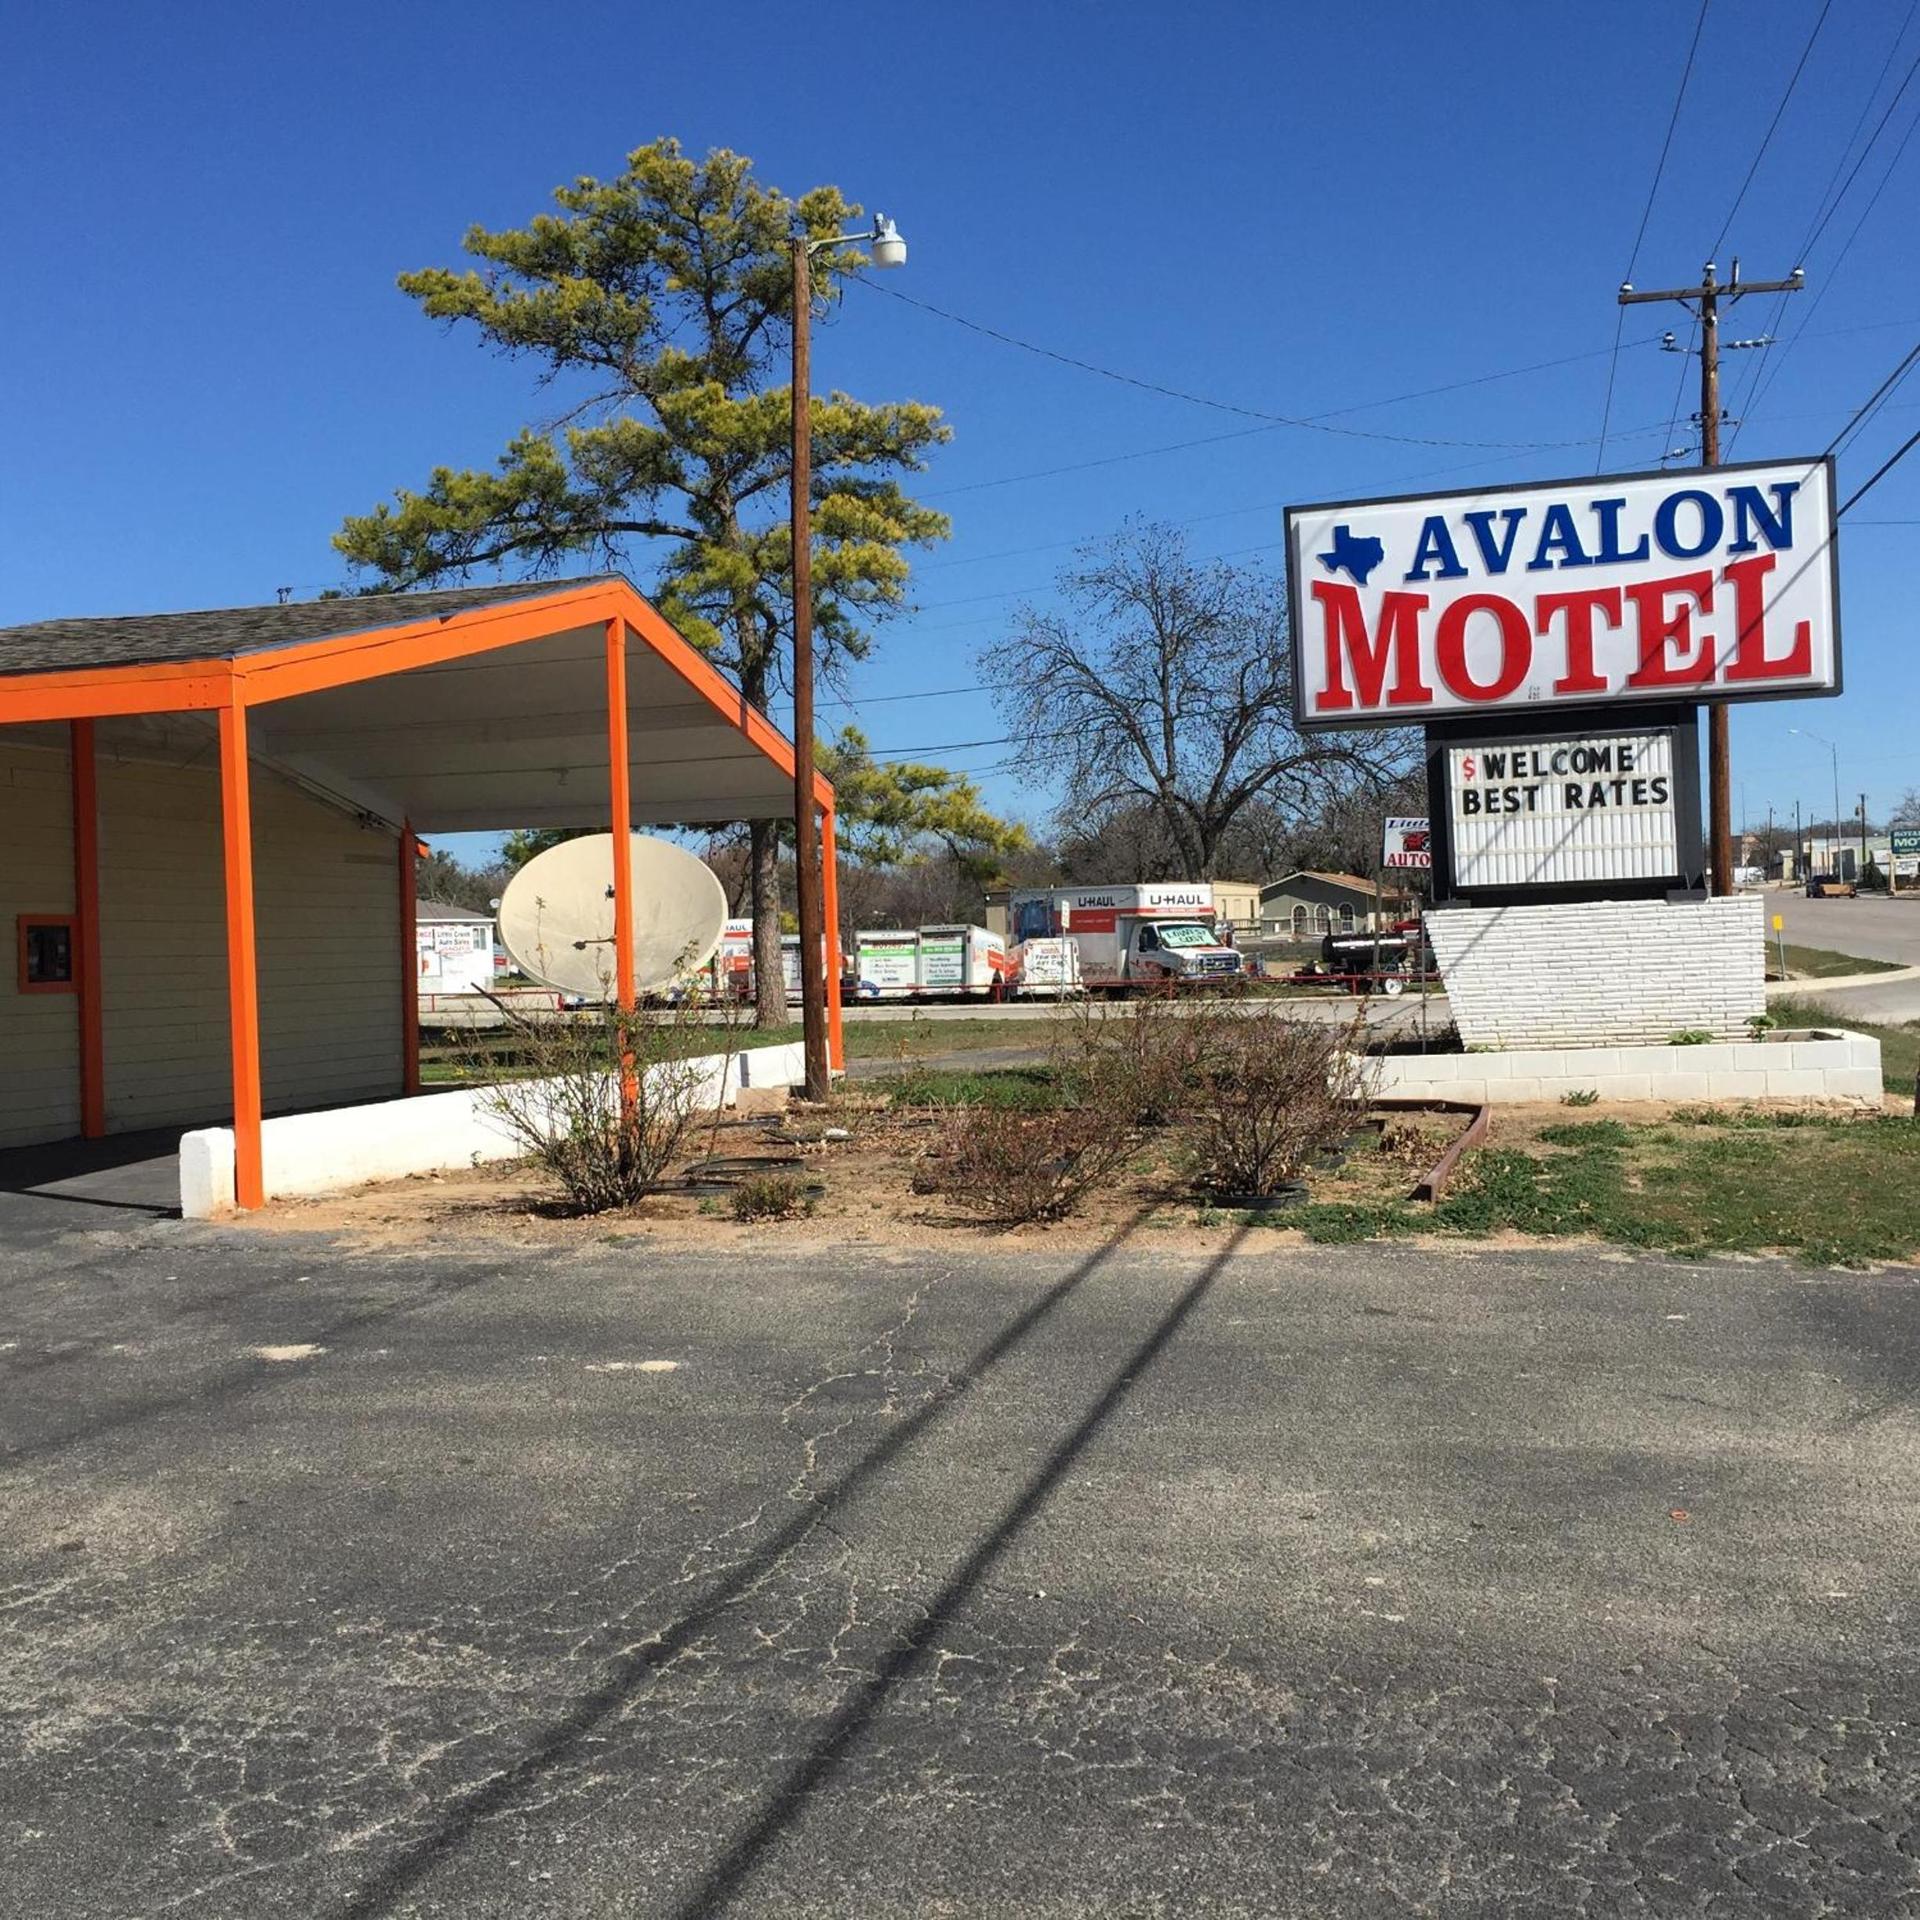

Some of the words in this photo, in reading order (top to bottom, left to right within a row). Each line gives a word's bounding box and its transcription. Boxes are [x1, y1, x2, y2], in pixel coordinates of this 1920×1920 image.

[1403, 481, 1801, 582] AVALON
[1311, 552, 1812, 712] MOTEL
[1463, 785, 1540, 815] BEST
[1564, 776, 1670, 809] RATES
[1387, 853, 1431, 867] AUTO
[1078, 895, 1115, 907] U-HAUL
[1150, 894, 1204, 905] U-HAUL
